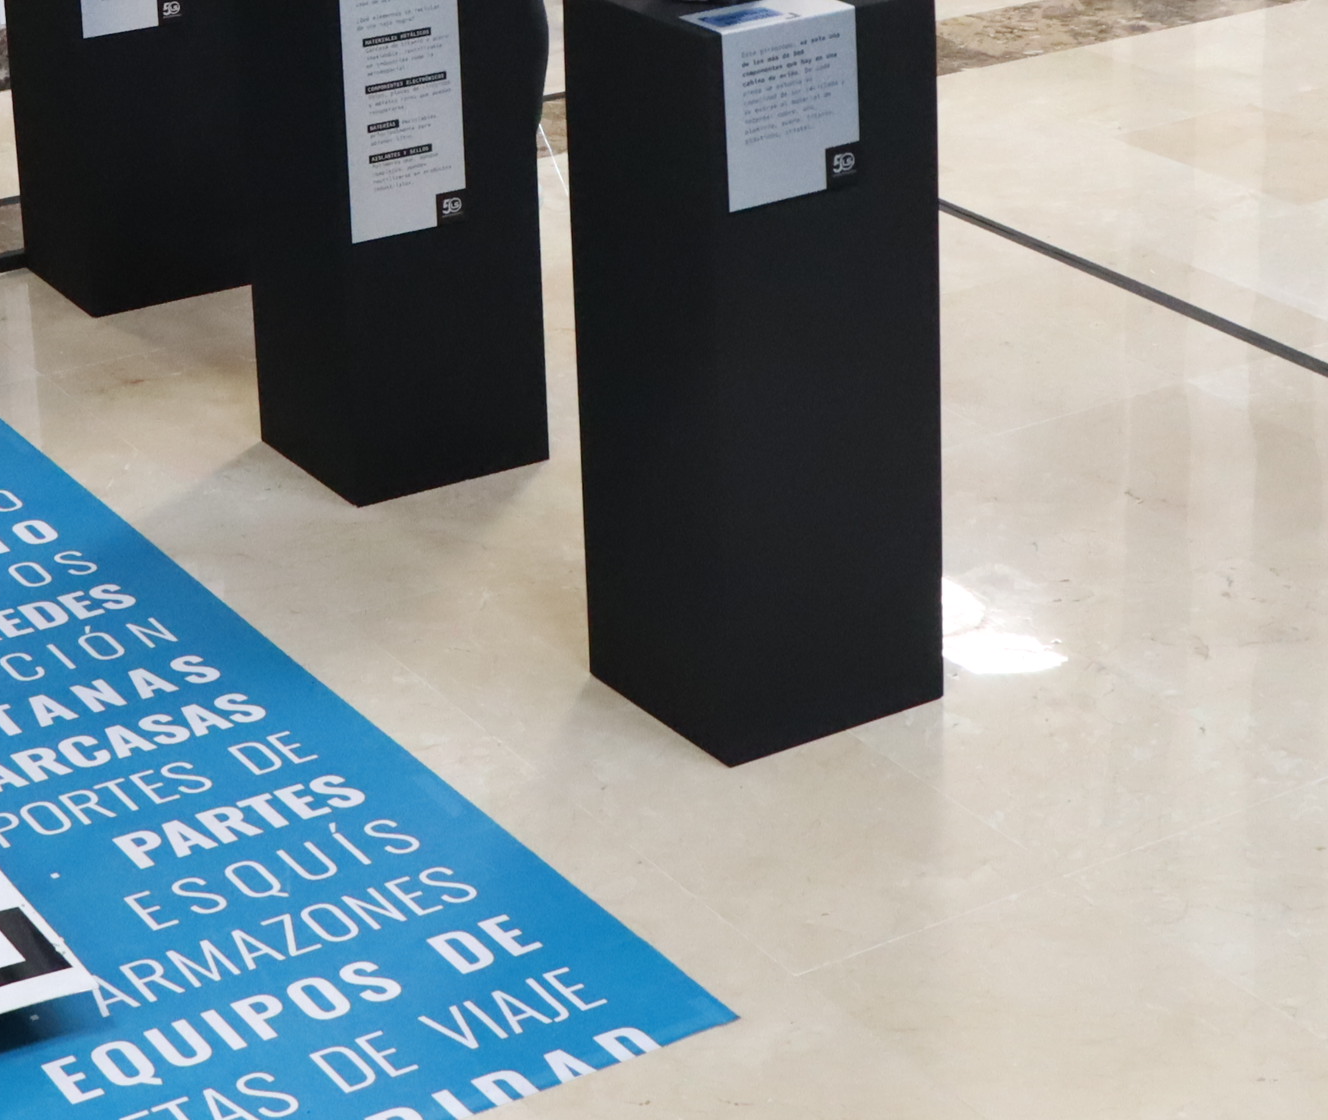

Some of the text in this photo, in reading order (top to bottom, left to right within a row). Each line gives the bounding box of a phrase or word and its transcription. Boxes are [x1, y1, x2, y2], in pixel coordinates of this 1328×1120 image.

[227, 731, 321, 776] DE
[111, 773, 367, 872] PARTES
[122, 818, 422, 932] ESQUÍS
[93, 865, 479, 1018] ARMAZONES
[40, 960, 403, 1104] EQUIPOS
[426, 912, 545, 975] DE
[309, 1028, 420, 1095] DE
[416, 965, 609, 1051] VIAJE
